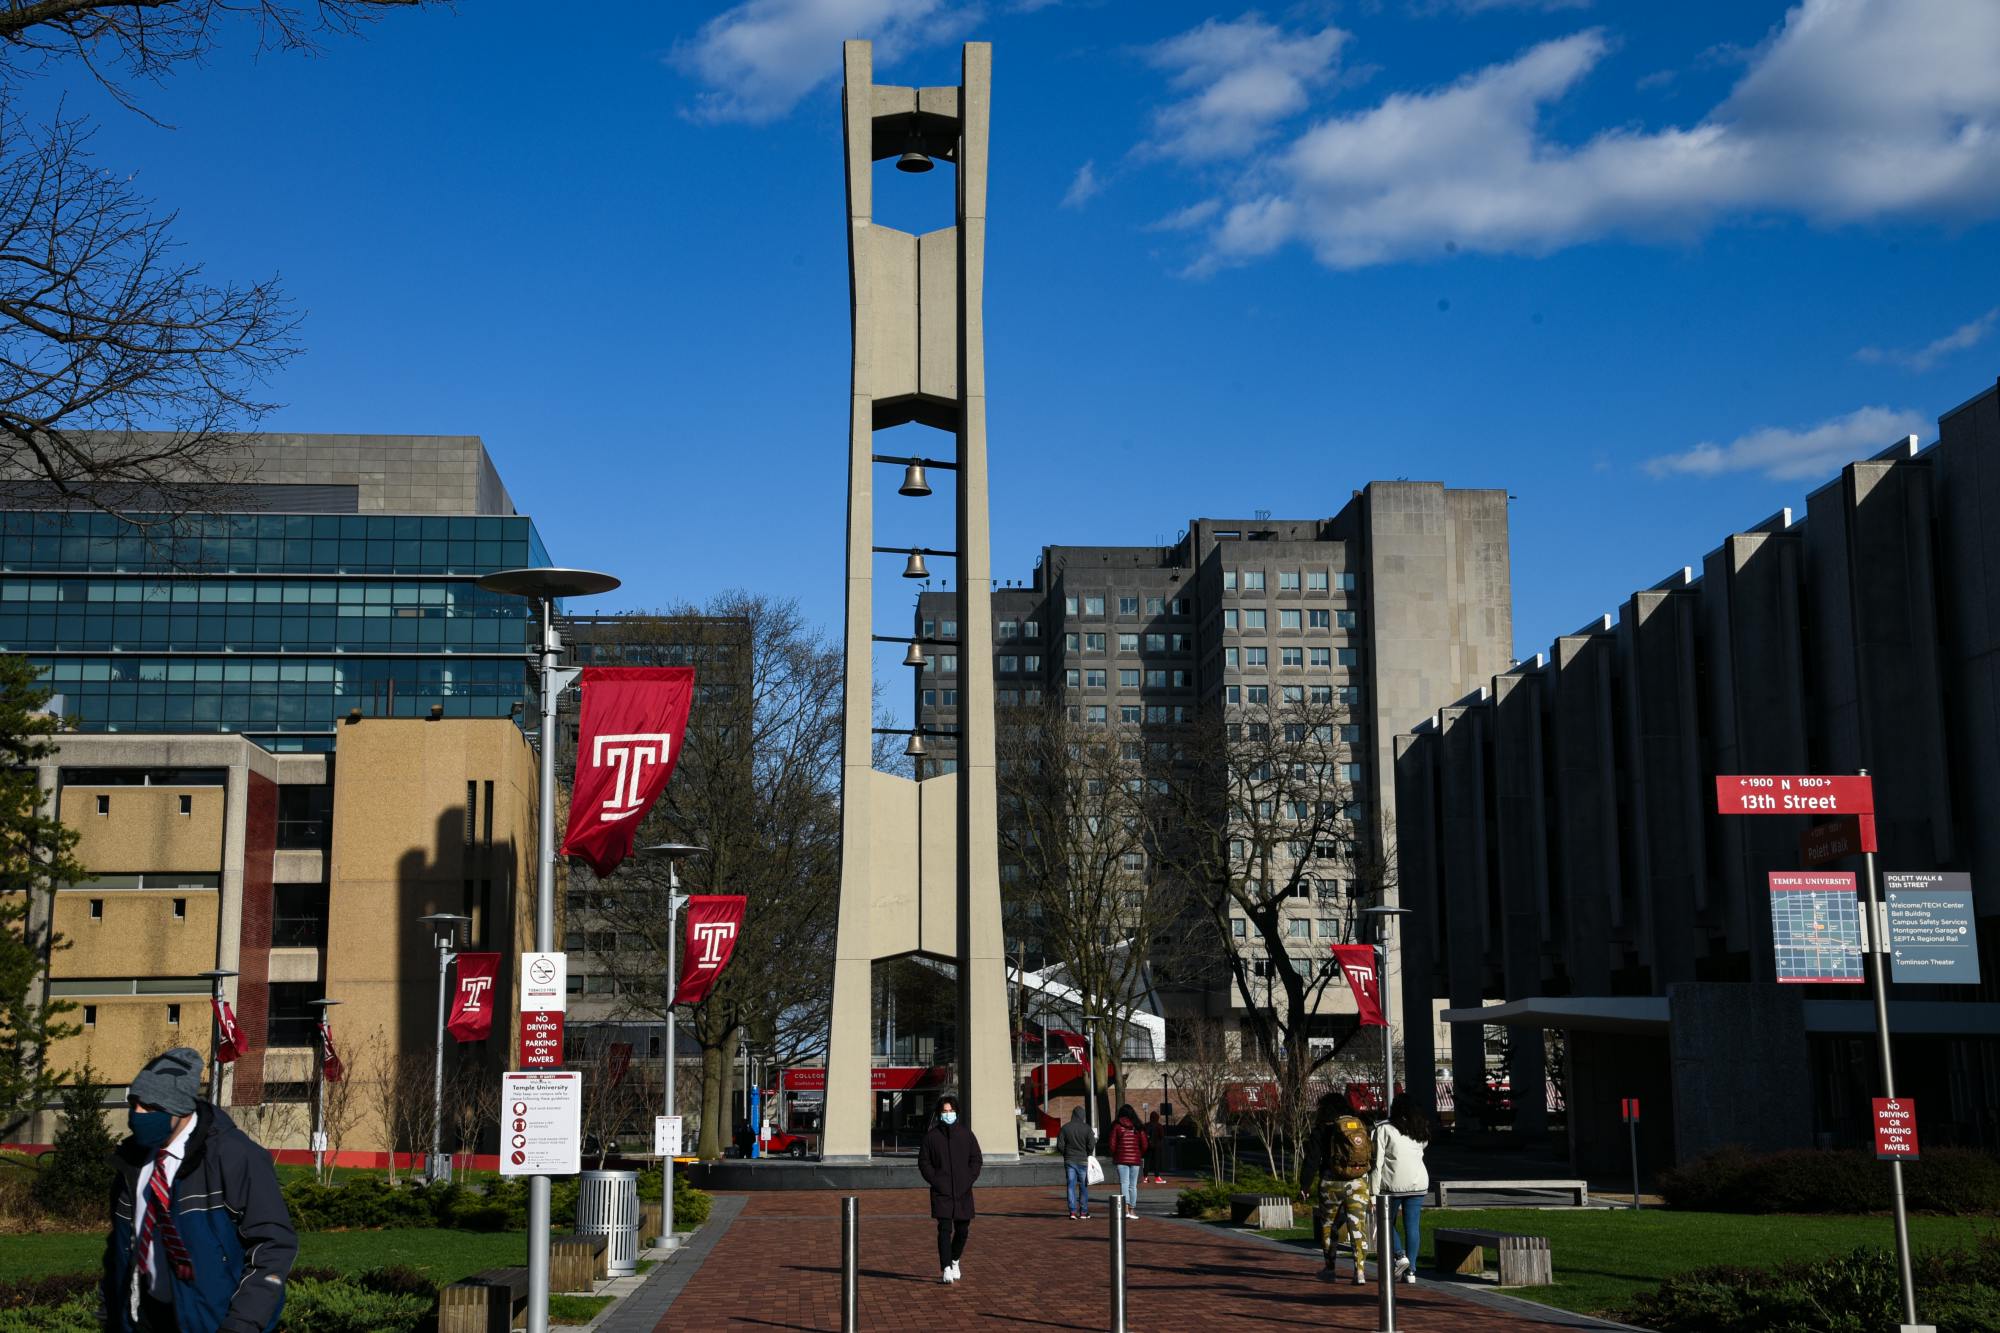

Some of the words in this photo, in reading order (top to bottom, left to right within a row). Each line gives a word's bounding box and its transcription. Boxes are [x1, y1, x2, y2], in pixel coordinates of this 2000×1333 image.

[1749, 778, 1774, 787] 1900
[1781, 779, 1791, 790] N
[1798, 778, 1823, 787] 1800
[1740, 795, 1776, 809] 13th
[1784, 795, 1837, 809] Street
